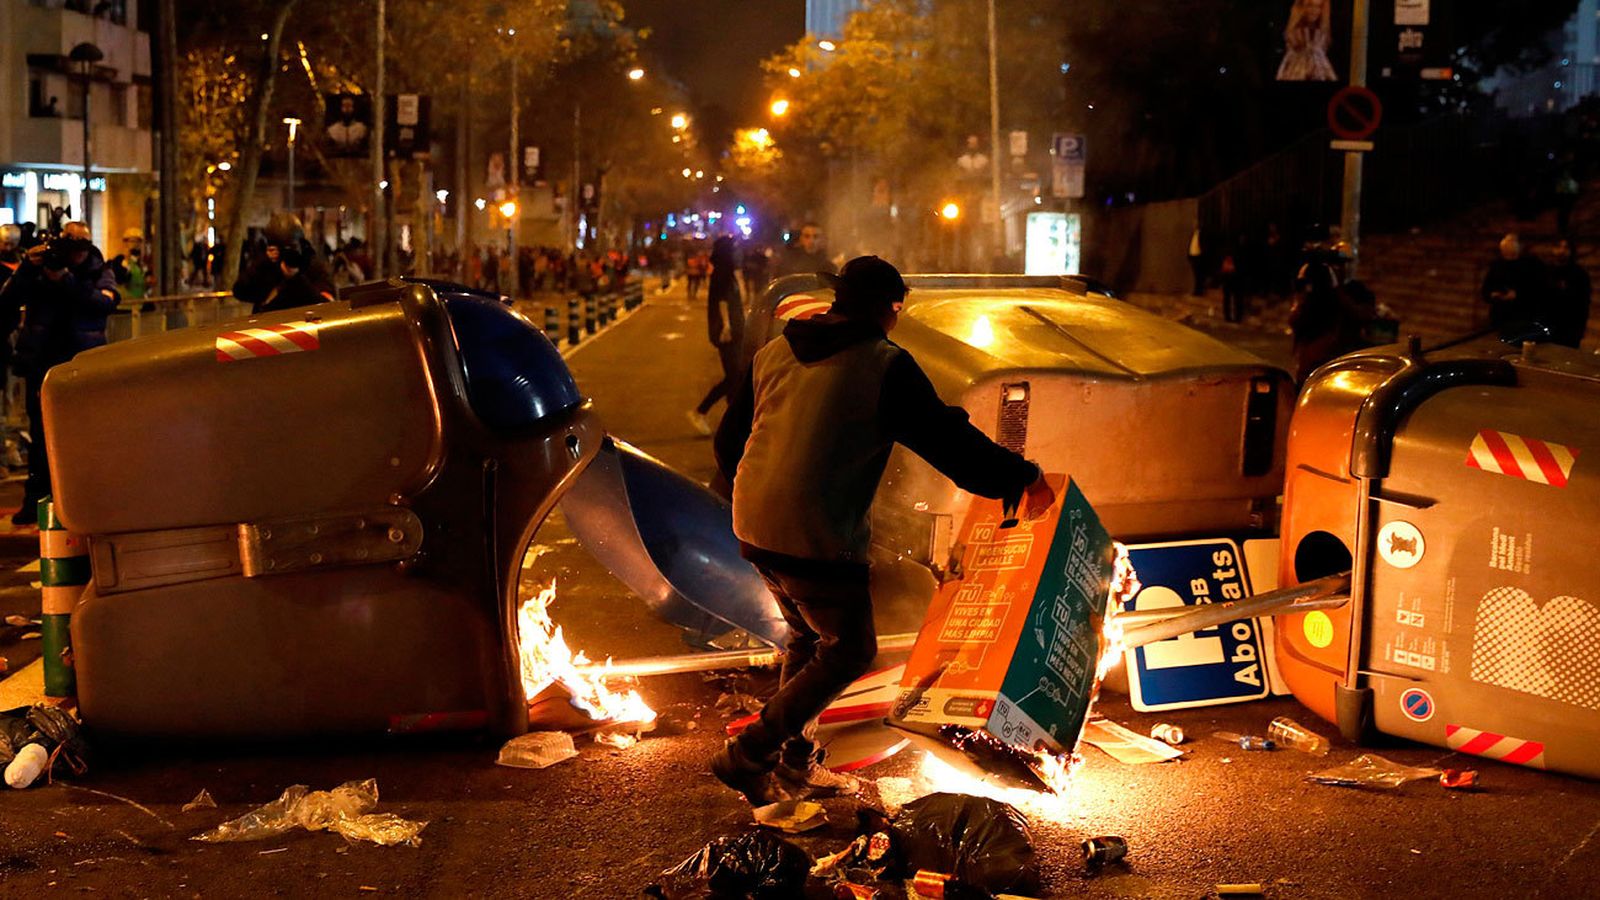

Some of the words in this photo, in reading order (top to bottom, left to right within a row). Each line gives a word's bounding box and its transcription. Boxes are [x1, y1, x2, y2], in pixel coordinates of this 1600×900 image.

[1061, 138, 1078, 157] P
[974, 527, 992, 541] YO
[1074, 535, 1085, 553] JO
[1489, 526, 1500, 568] Barcelona
[954, 607, 979, 616] VIVES
[979, 607, 993, 616] EN
[1055, 602, 1068, 623] TU
[1212, 550, 1261, 687] Aboats
[968, 618, 1001, 628] CIUDAD
